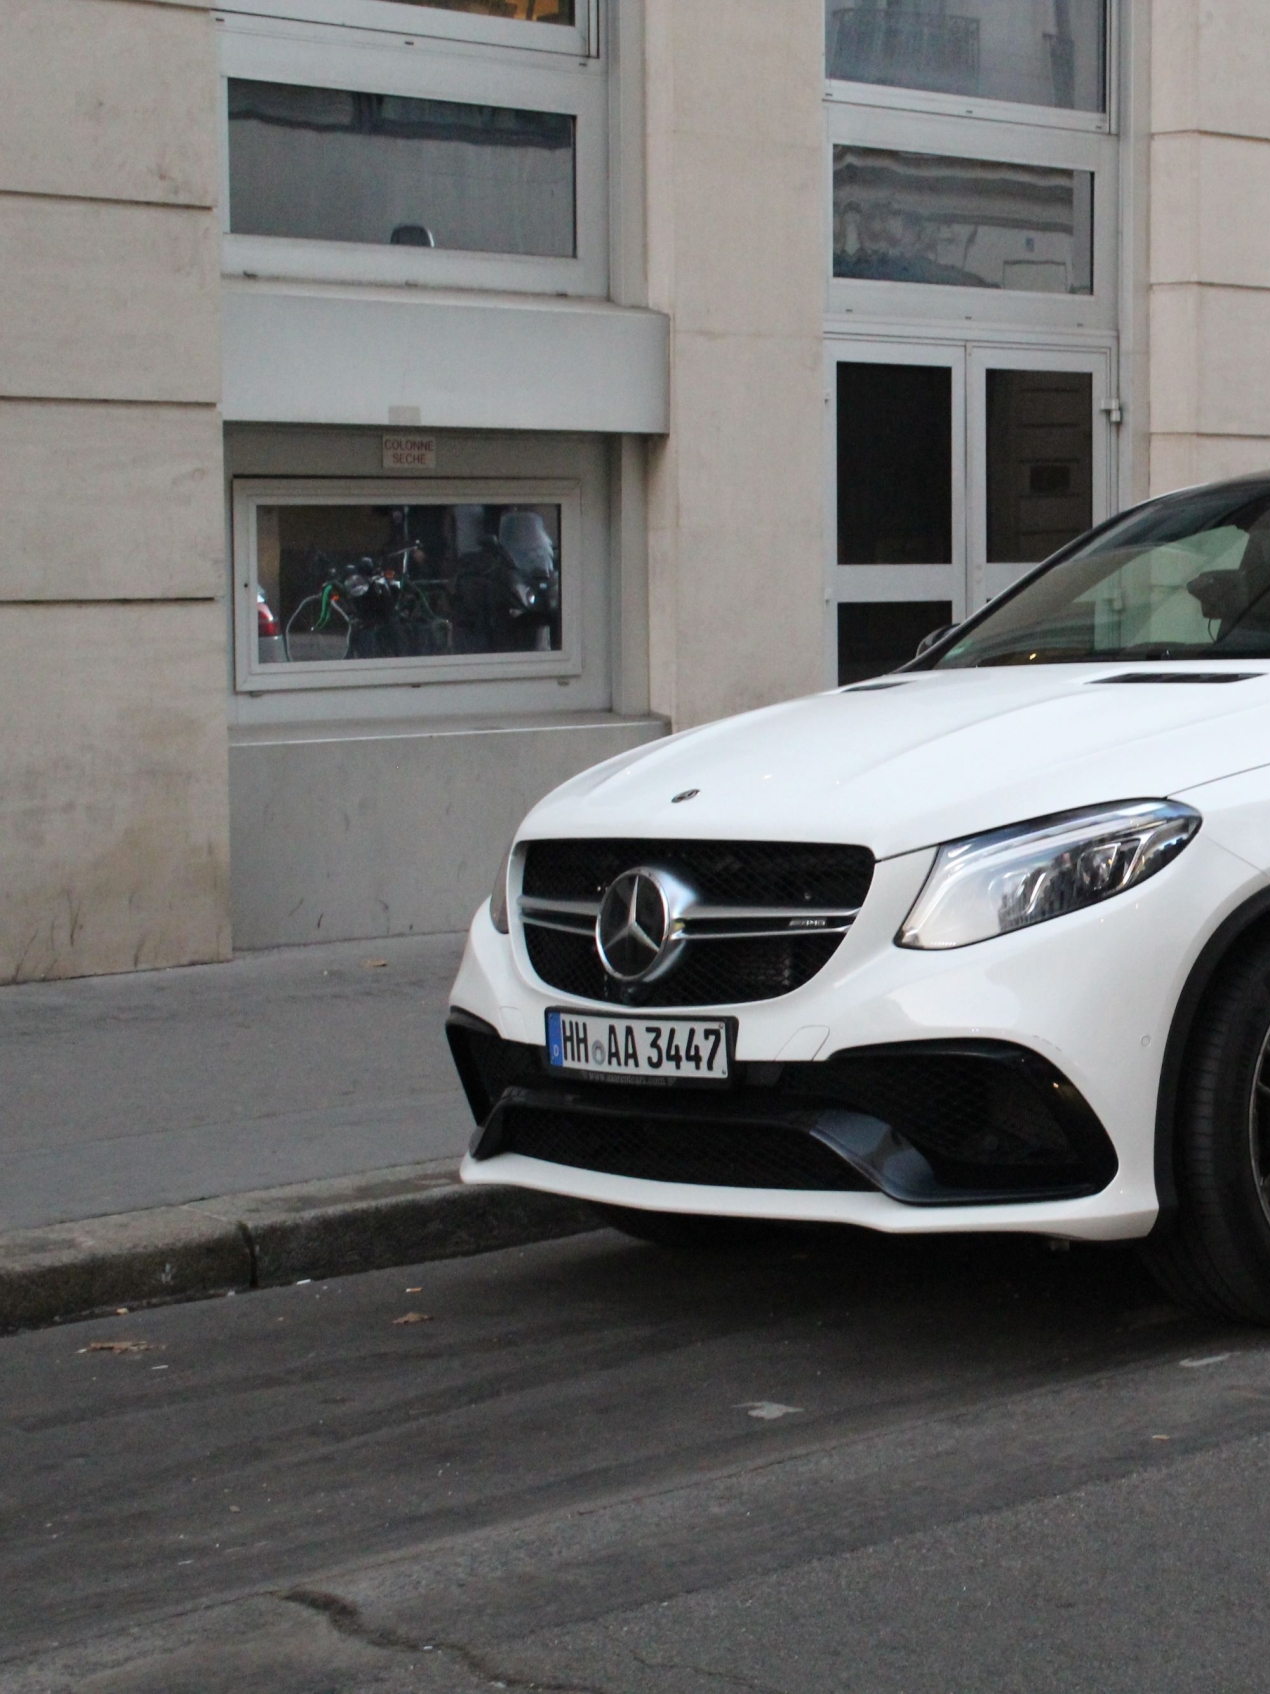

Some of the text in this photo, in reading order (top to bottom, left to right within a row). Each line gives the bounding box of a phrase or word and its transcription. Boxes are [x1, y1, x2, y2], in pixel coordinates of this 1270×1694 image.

[384, 438, 433, 451] COLONNE
[562, 1019, 721, 1071] HH AA 3447
